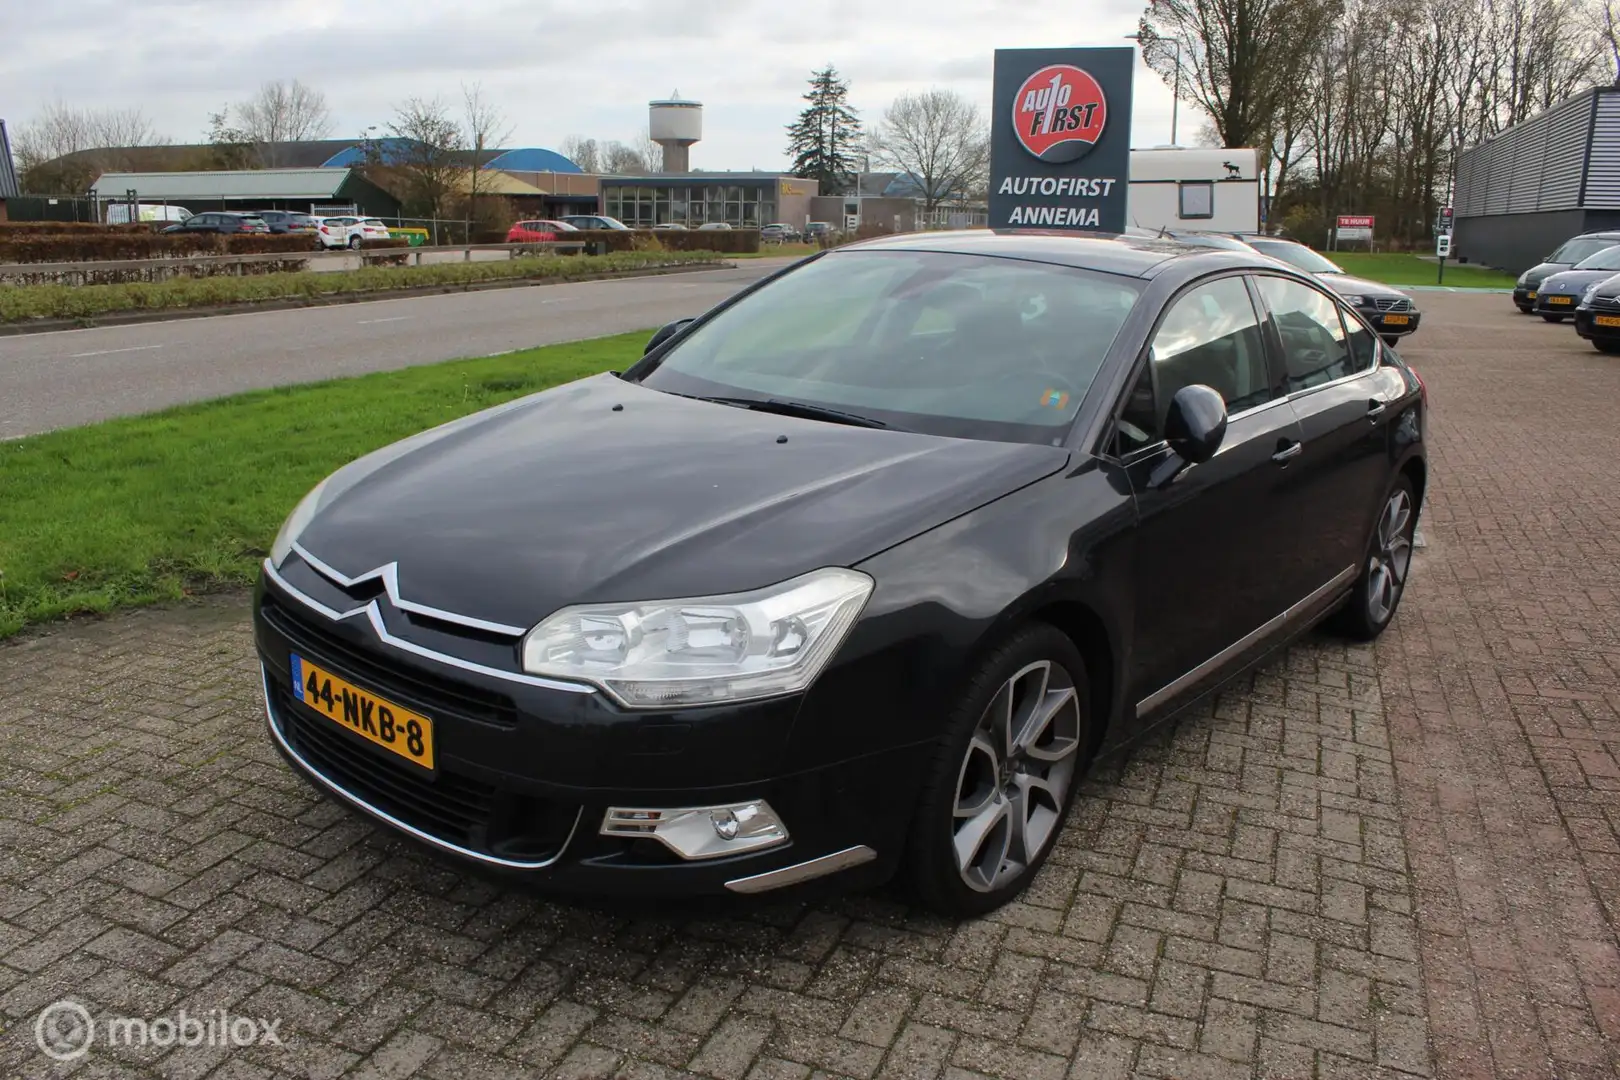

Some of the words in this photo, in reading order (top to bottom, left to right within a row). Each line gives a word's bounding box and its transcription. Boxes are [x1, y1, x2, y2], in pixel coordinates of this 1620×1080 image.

[998, 176, 1116, 197] AUTOFIRST
[1008, 206, 1100, 226] ANNEMA
[306, 670, 425, 757] 44-NKB-8
